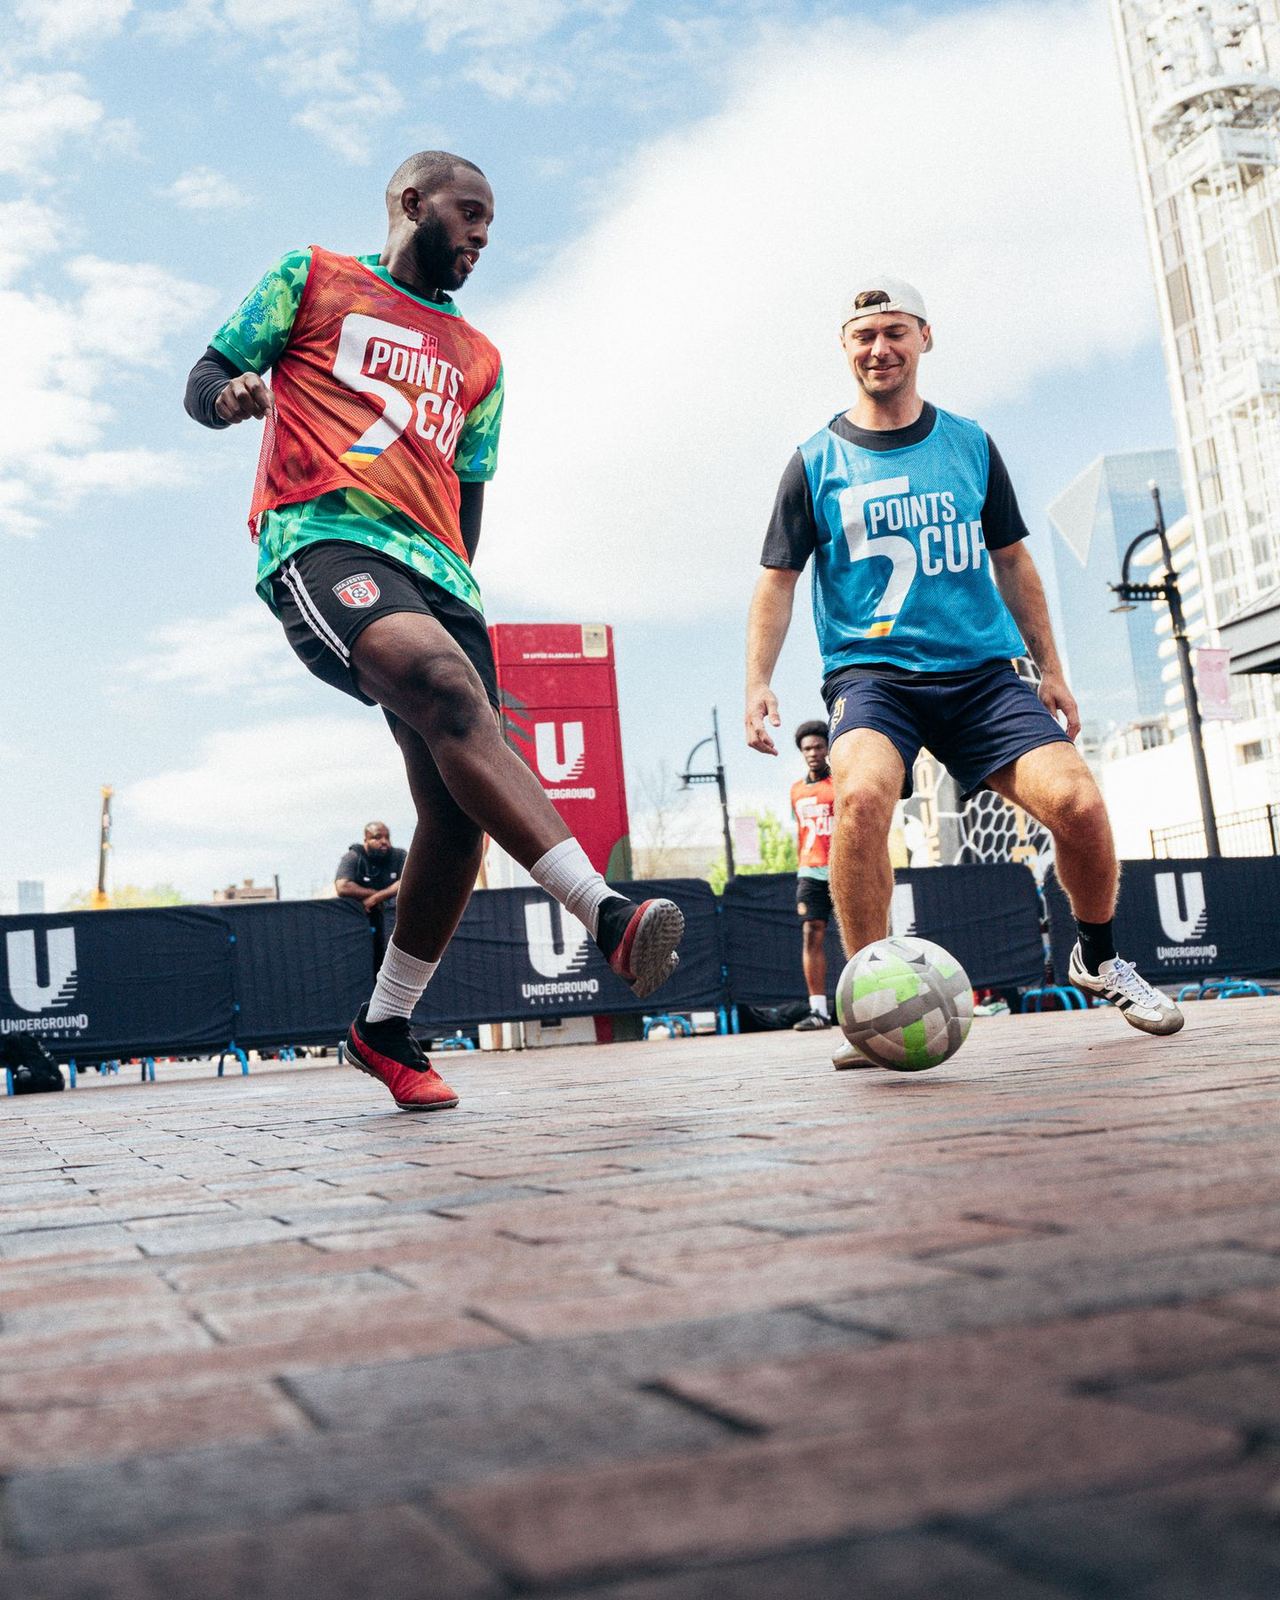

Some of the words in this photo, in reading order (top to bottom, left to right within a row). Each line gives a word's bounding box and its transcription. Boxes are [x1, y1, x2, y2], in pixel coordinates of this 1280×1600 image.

[332, 312, 424, 470] 5
[366, 341, 464, 400] POINTS
[868, 491, 957, 535] POINTS
[838, 475, 917, 638] 5
[534, 721, 585, 783] U
[544, 787, 596, 800] DERGROUND
[1154, 871, 1208, 943] U
[6, 926, 78, 1013] U
[524, 901, 589, 978] U
[1156, 944, 1218, 960] UNDERGROUND
[521, 978, 599, 998] UNDERGROUND
[0, 1013, 88, 1034] UNDERGROUND
